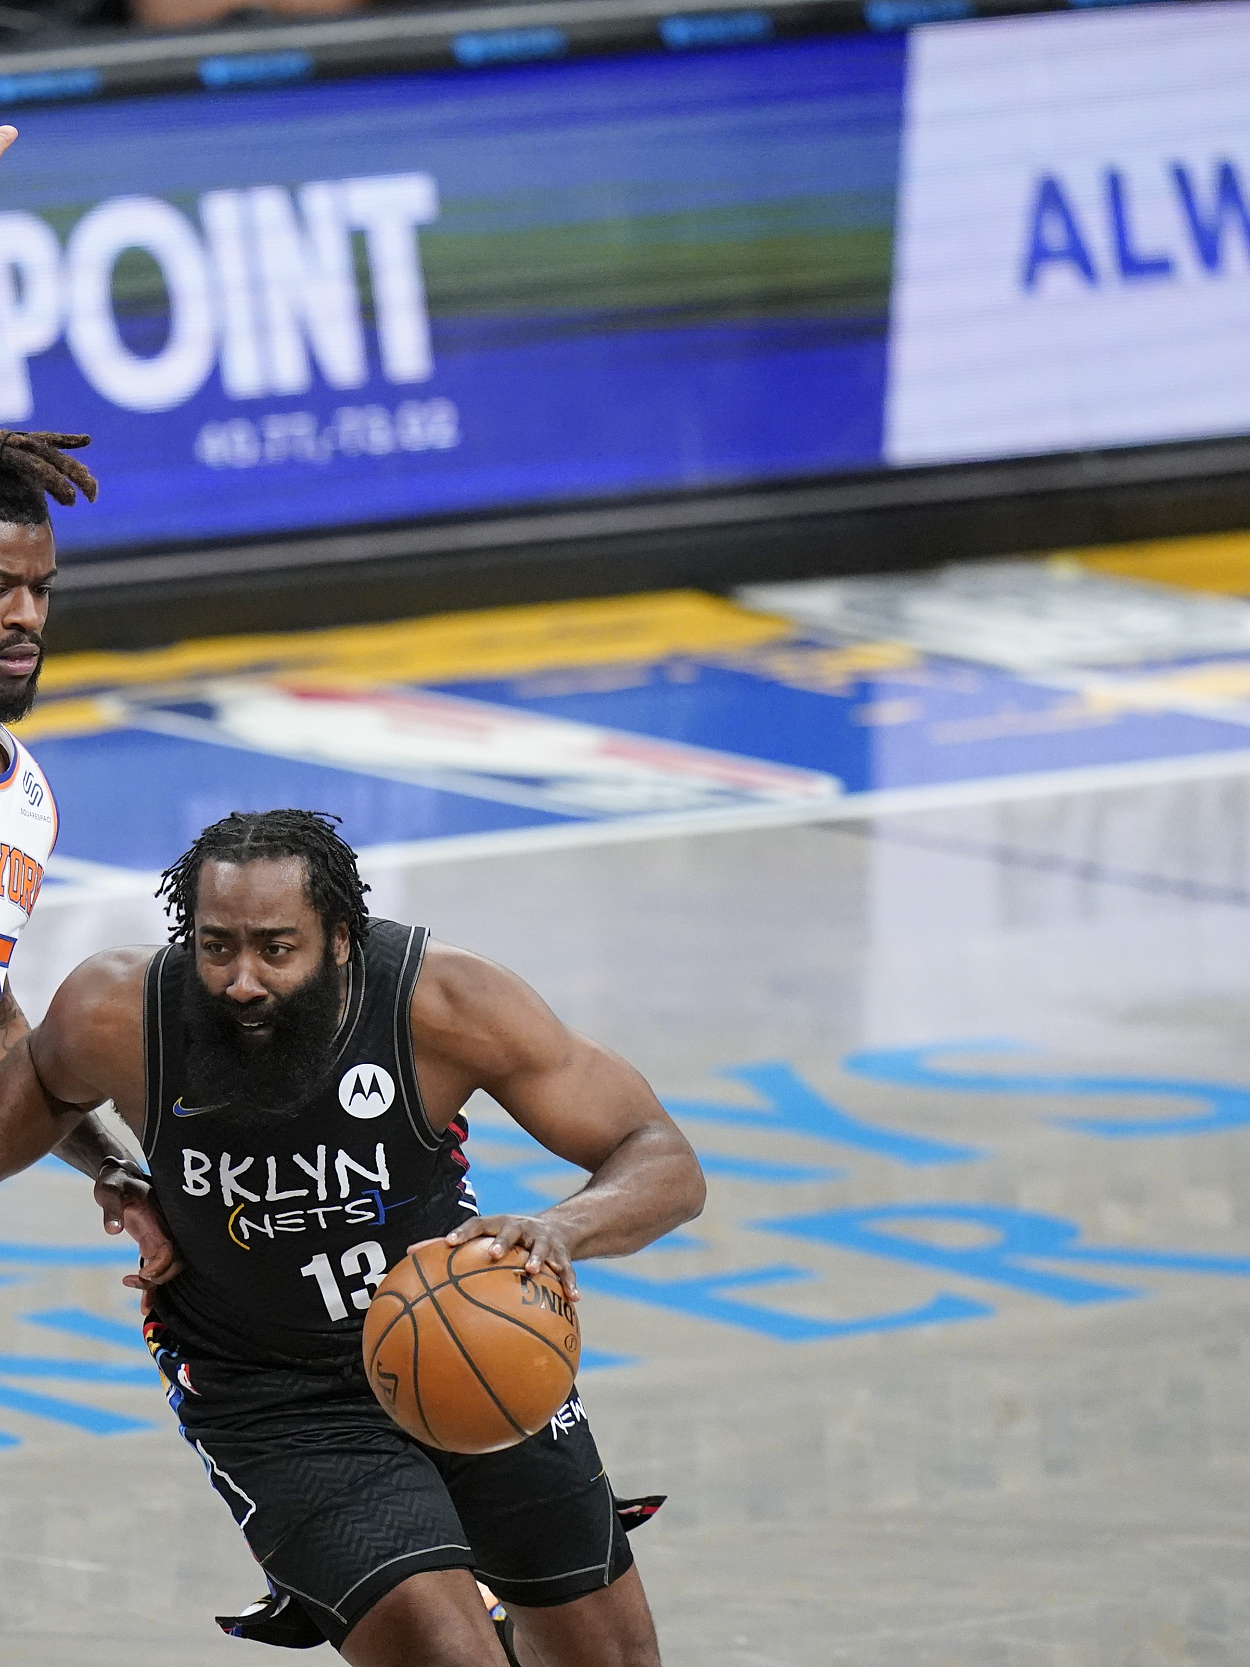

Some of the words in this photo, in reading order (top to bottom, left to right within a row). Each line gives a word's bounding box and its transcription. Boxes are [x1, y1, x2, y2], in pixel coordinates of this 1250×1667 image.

[1022, 158, 1250, 292] ALW
[182, 1142, 390, 1206] BKLYN
[301, 1240, 389, 1322] 13
[550, 1396, 588, 1440] NEW
